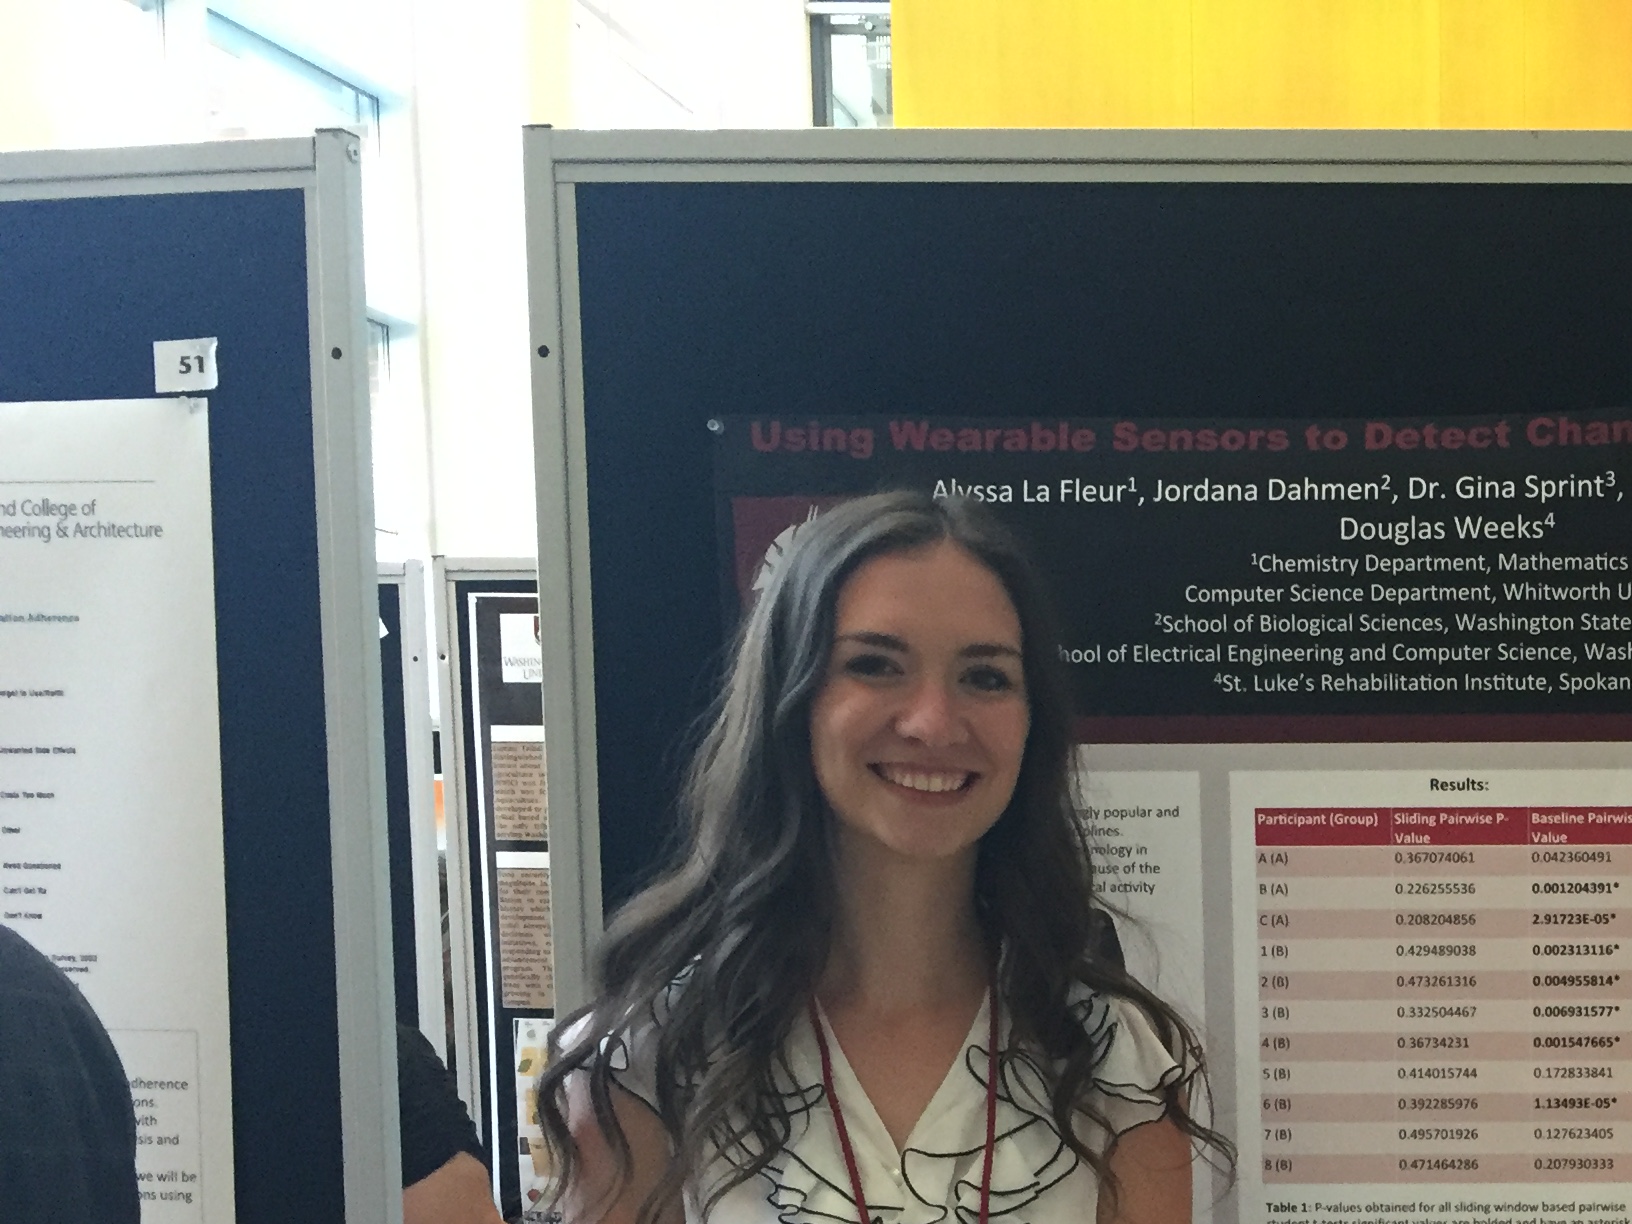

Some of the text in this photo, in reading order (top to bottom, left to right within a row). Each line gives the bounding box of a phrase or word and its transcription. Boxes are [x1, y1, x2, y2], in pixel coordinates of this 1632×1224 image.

[178, 355, 206, 374] 51
[750, 420, 873, 458] Using
[889, 419, 1095, 453] Wearable
[1112, 419, 1288, 452] Sensors
[1303, 424, 1348, 451] to
[1363, 420, 1509, 451] Detect
[933, 478, 1012, 502] Alyssa
[1023, 479, 1049, 502] La
[1152, 477, 1257, 502] Jordana
[1409, 477, 1445, 499] Dr.
[1455, 475, 1515, 499] Gina
[55, 520, 69, 538] &
[1340, 514, 1445, 546] Douglas
[1365, 554, 1490, 575] Department,
[1498, 552, 1628, 570] Mathematics
[1185, 584, 1284, 606] Computer
[1290, 583, 1363, 602] Science
[1371, 583, 1496, 605] Department,
[1502, 581, 1610, 601] Whitworth
[1233, 613, 1254, 632] of
[1260, 613, 1352, 636] Biological
[1359, 613, 1448, 634] Sciences,
[1455, 612, 1573, 635] Washington
[1580, 612, 1631, 630] State
[1107, 643, 1127, 662] of
[1133, 643, 1220, 662] Electrical
[1228, 643, 1343, 666] Engineering
[1349, 643, 1385, 661] and
[1392, 643, 1491, 664] Computer
[1497, 642, 1577, 663] Science,
[1254, 673, 1314, 691] Luke's
[1321, 672, 1457, 691] Rehabilitation
[1465, 673, 1552, 693] Institute,
[1430, 777, 1489, 791] Results:
[1103, 805, 1179, 820] popular and
[1257, 812, 1378, 827] Participant (Group)
[1394, 812, 1436, 826] Sliding
[1439, 812, 1492, 824] Pairwise
[1531, 811, 1584, 824] Baseline
[1394, 832, 1430, 843] Value
[1531, 831, 1567, 842] Value
[1122, 861, 1160, 874] of the
[1109, 881, 1155, 895] activity
